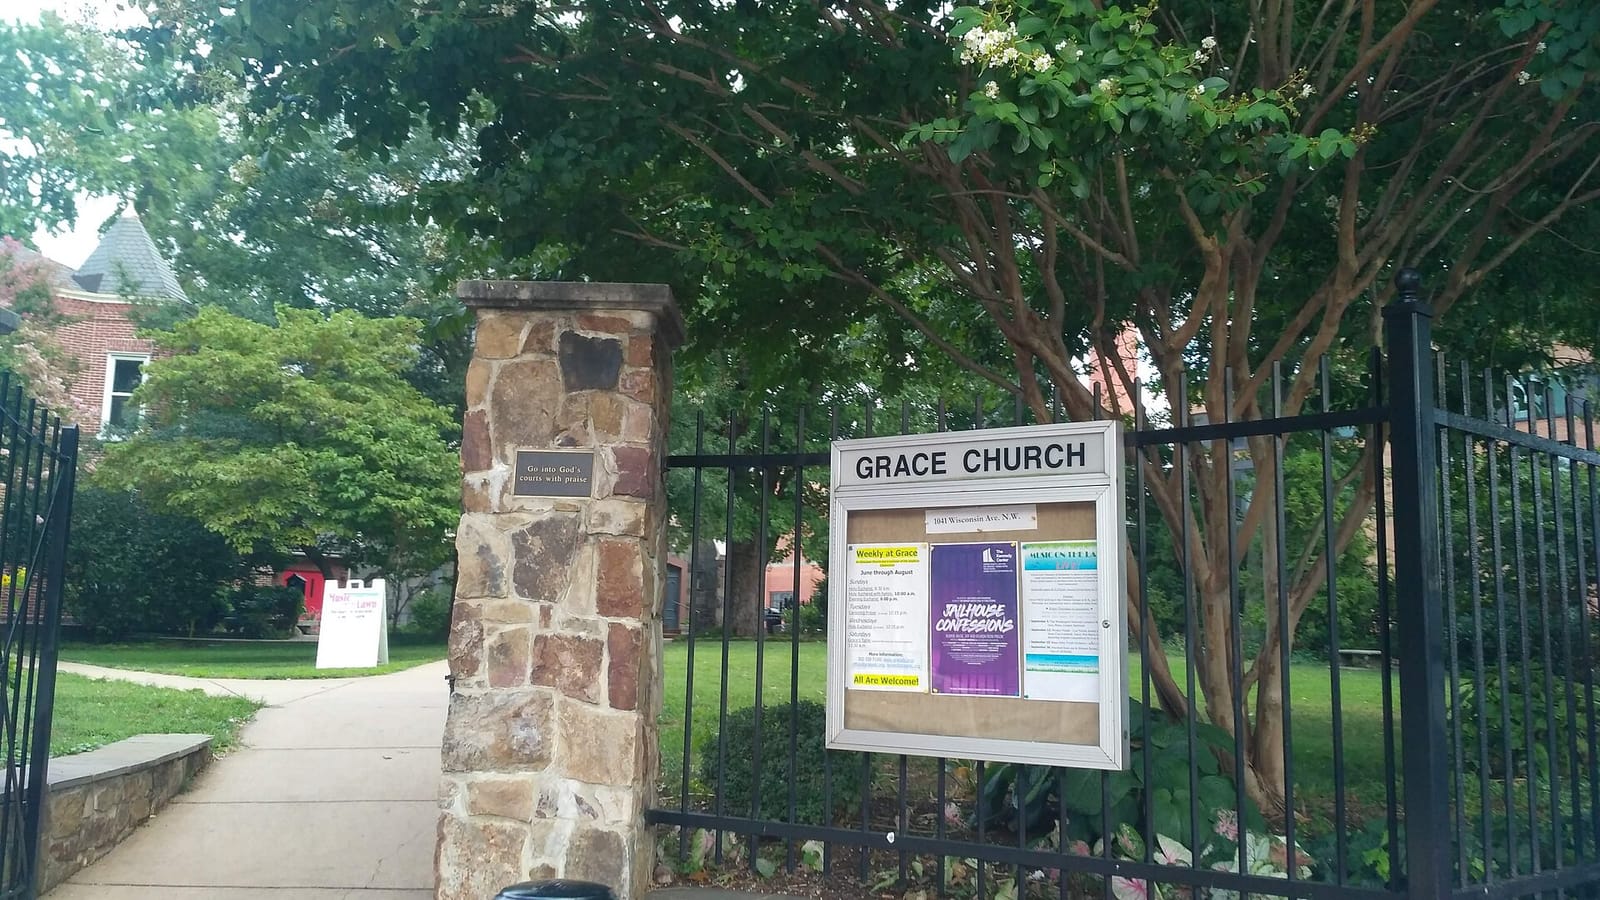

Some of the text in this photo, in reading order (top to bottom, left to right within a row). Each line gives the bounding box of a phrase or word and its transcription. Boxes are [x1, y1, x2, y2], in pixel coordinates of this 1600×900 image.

[855, 442, 1086, 480] GRACE CHURCH
[527, 465, 581, 473] Go into God's
[565, 476, 588, 484] praise
[934, 517, 948, 525] 1041
[948, 516, 984, 524] Wisconsin
[1002, 512, 1021, 521] N.W.
[856, 550, 884, 559] Weekly
[896, 549, 918, 557] Grace
[942, 603, 1006, 619] JAILHOUSE
[935, 616, 1014, 633] CONFESSIONS
[854, 676, 863, 684] All
[880, 677, 919, 686] Welcome!
